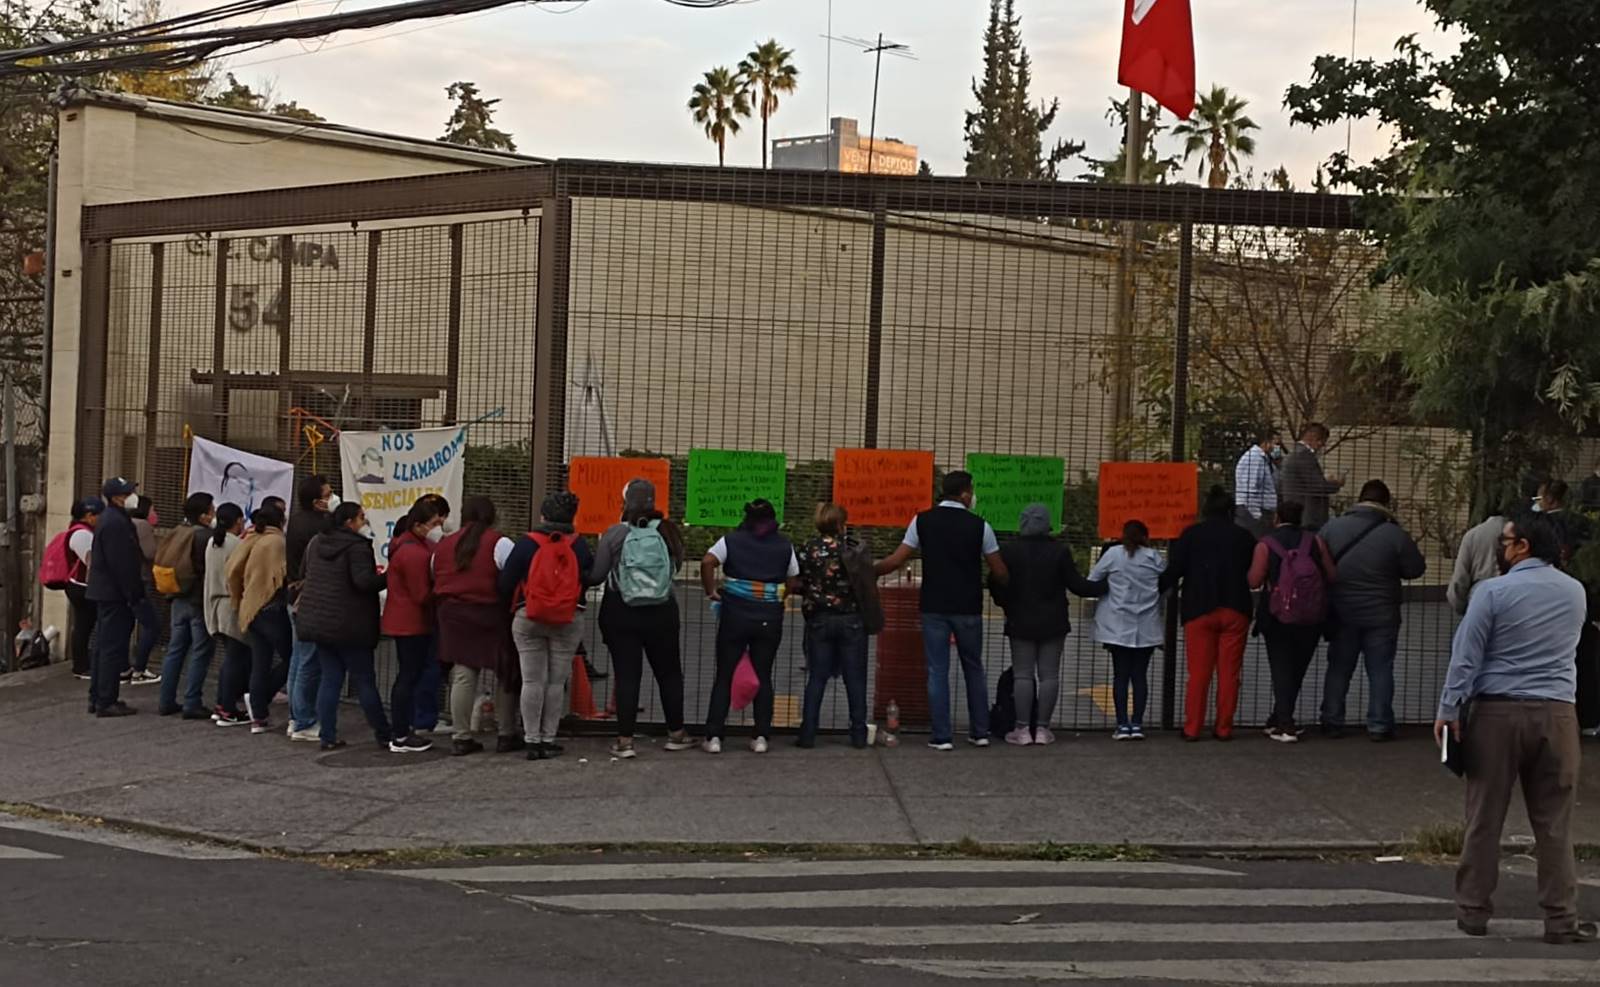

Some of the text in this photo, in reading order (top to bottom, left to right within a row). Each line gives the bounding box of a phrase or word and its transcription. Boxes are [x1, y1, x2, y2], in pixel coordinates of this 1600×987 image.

[879, 154, 913, 172] DEPTOS
[249, 237, 339, 270] CAMPA
[228, 284, 292, 334] 54
[382, 432, 415, 452] NOS
